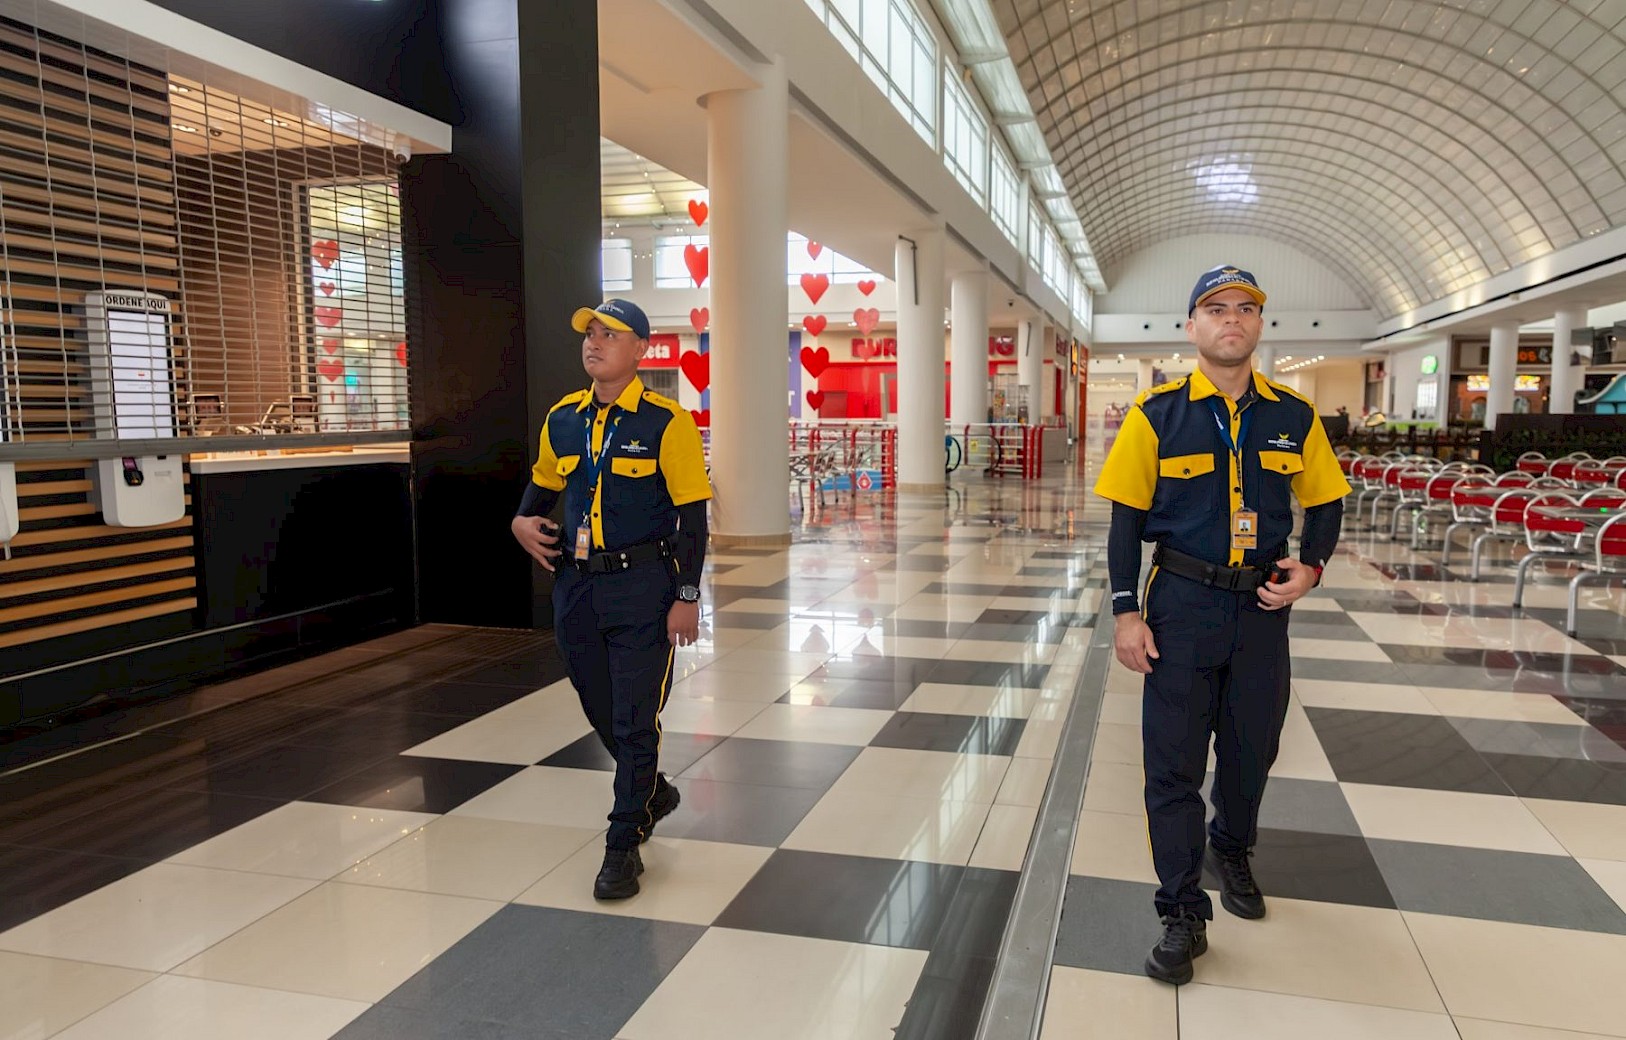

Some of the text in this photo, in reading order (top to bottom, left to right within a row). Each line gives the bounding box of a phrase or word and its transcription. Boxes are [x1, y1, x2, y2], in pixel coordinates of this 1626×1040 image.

[106, 296, 166, 309] ORDENE AQUI
[643, 343, 670, 359] eta
